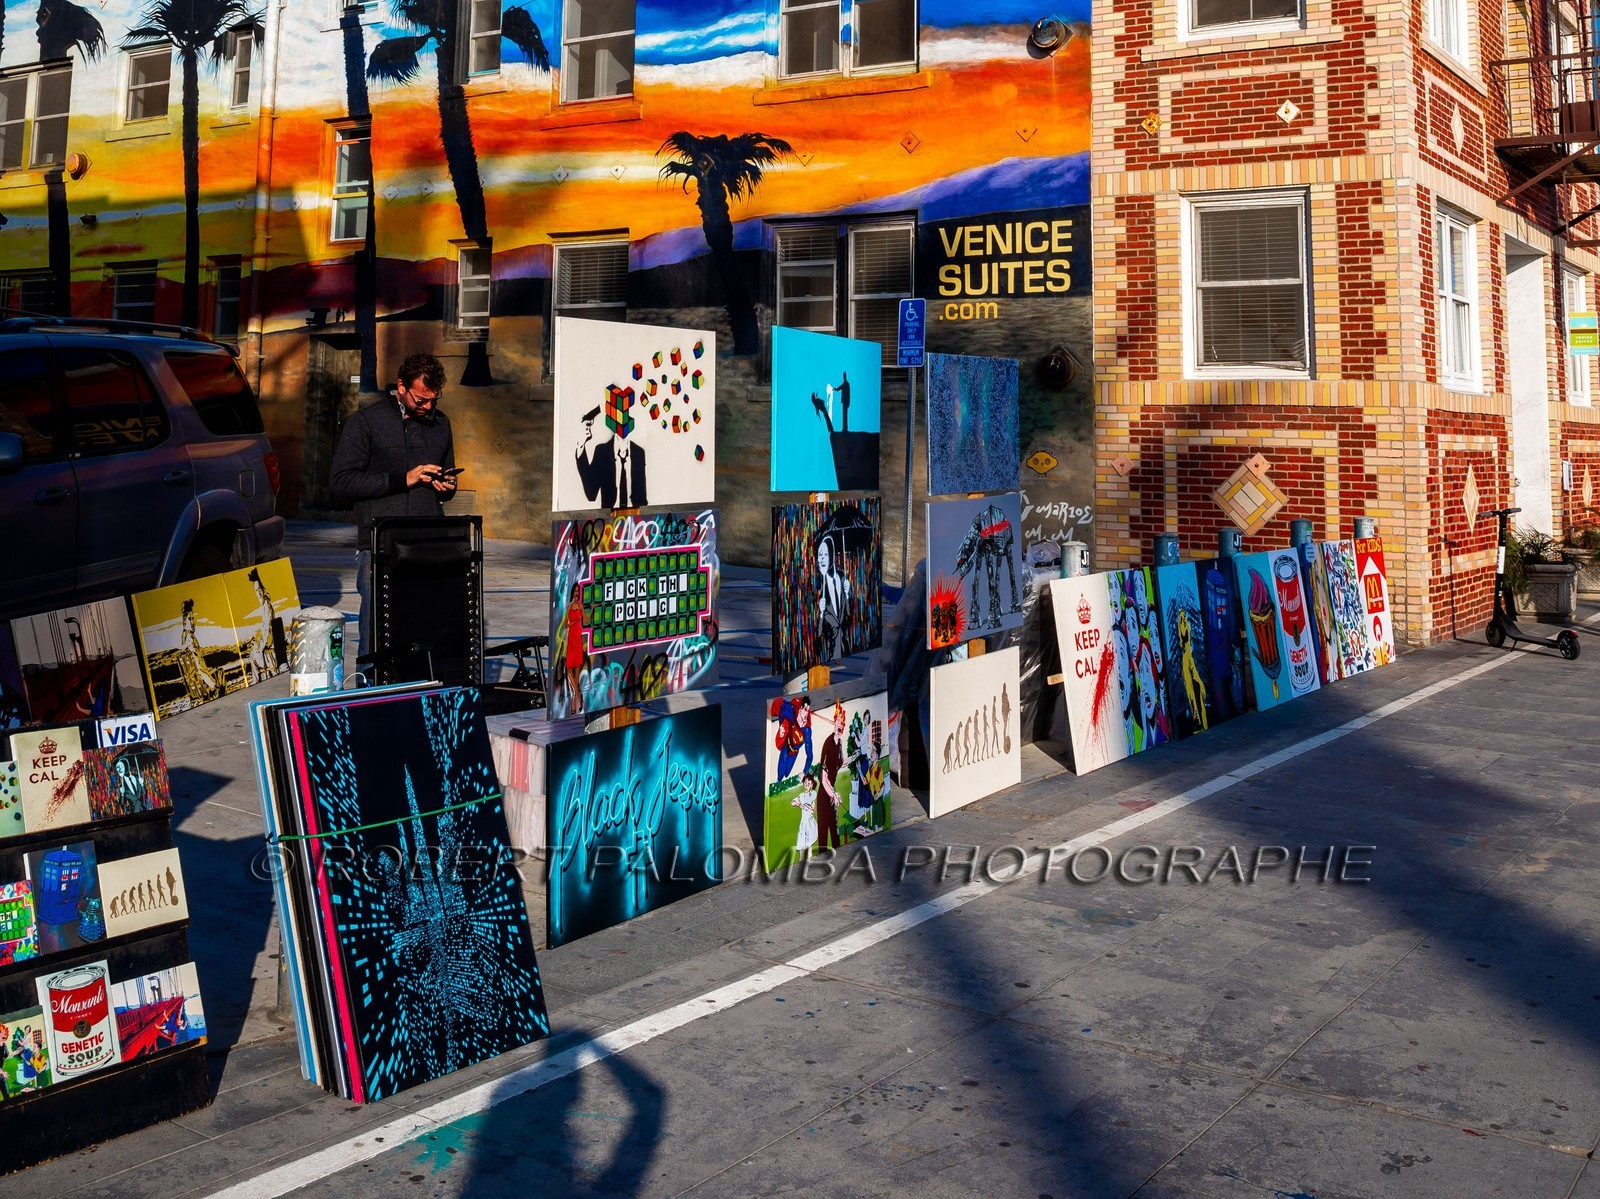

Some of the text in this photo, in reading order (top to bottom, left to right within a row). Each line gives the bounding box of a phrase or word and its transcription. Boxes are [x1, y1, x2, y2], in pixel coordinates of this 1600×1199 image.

[939, 220, 1073, 258] VENICE
[939, 259, 1071, 296] SUITES
[939, 301, 998, 321] .com
[1074, 628, 1100, 651] KEEP
[1075, 656, 1097, 679] CAL
[1294, 661, 1309, 677] SOUP
[104, 722, 152, 745] VISA
[32, 754, 67, 770] KEEP
[29, 770, 59, 784] CAL
[559, 728, 641, 866] Black
[61, 1031, 105, 1054] GENETIC
[67, 1045, 103, 1065] SOUP
